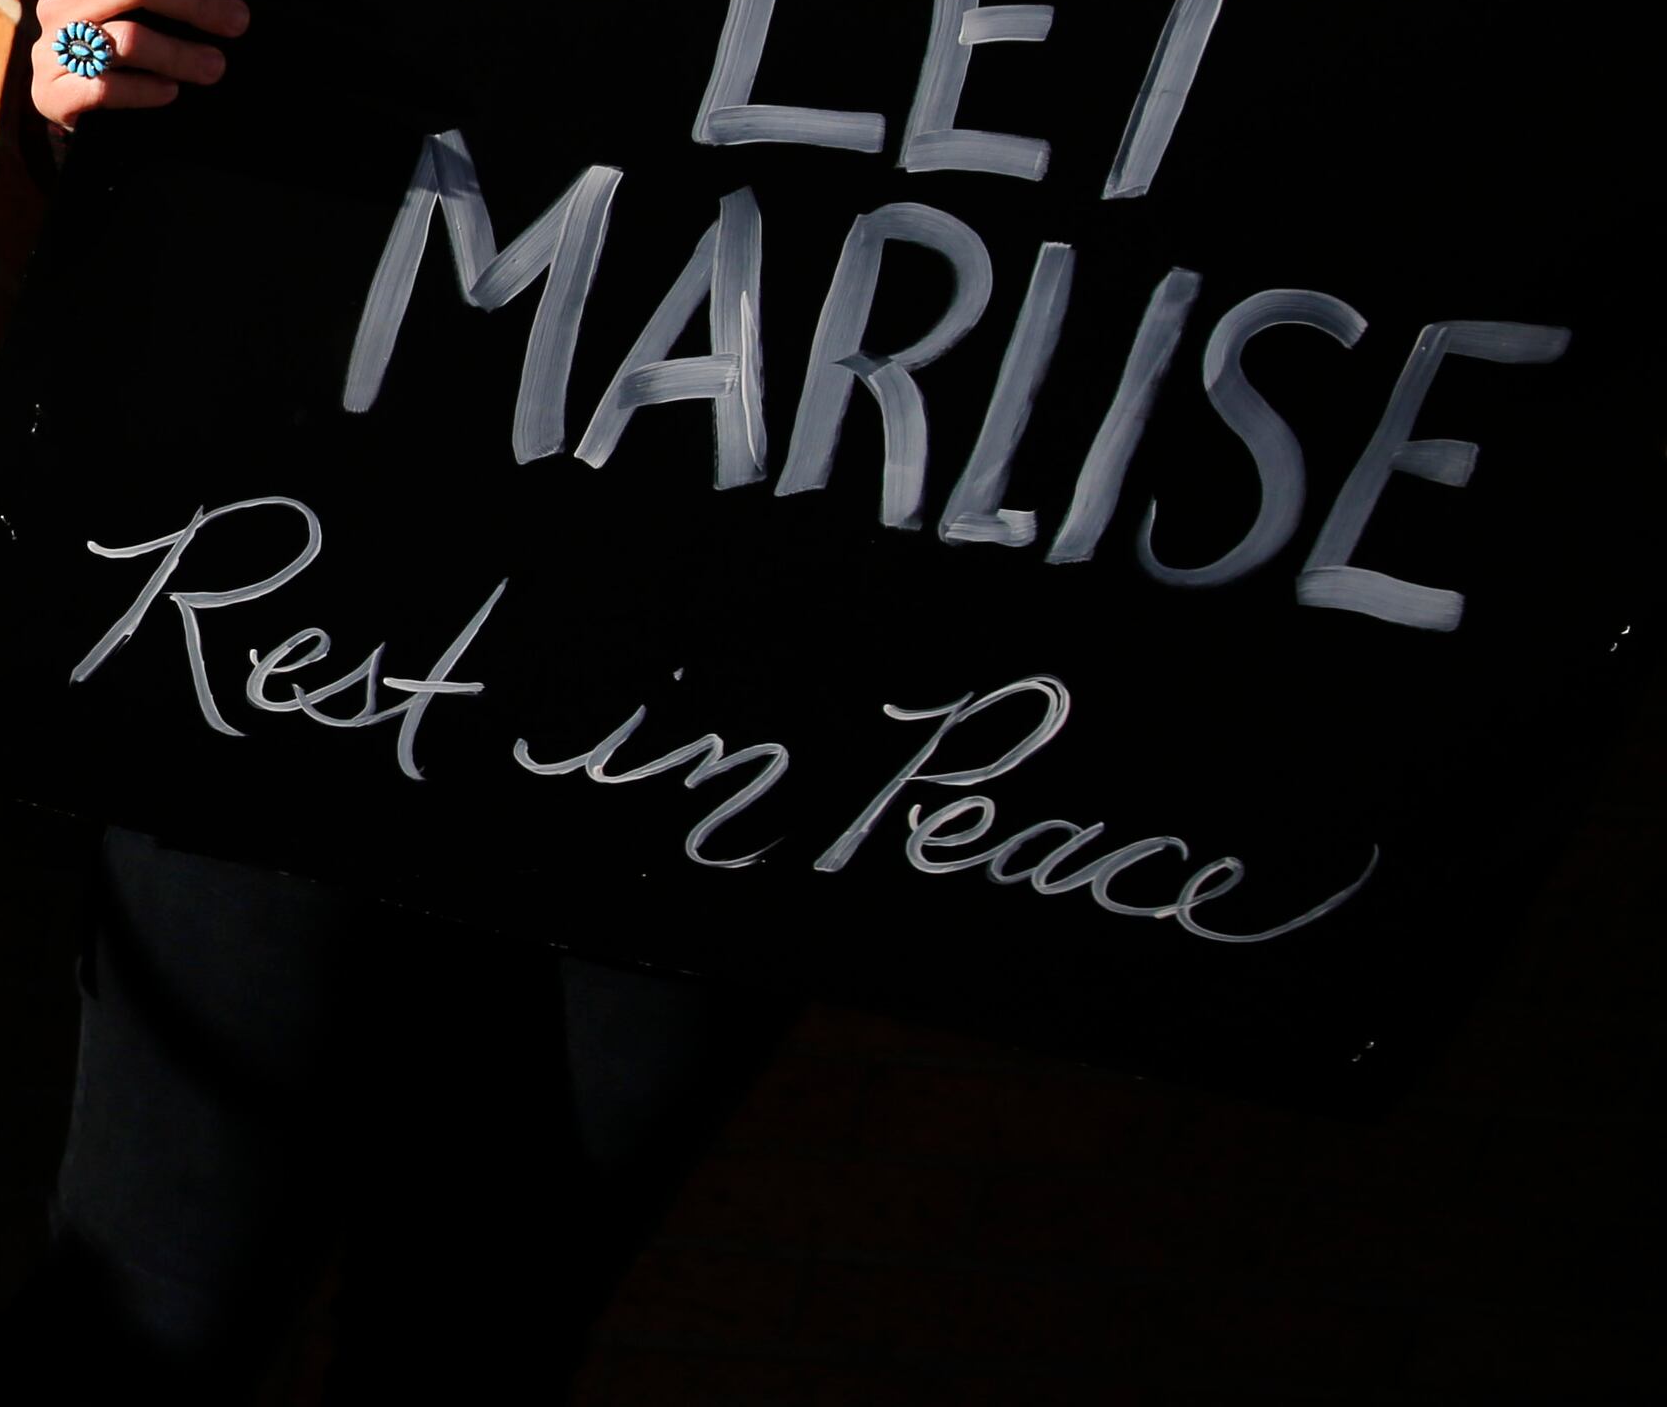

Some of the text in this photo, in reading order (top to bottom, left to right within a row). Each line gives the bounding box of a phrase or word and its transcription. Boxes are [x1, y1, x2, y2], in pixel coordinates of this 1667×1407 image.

[342, 128, 1573, 632] MARLISE
[69, 495, 1380, 944] Rest in Peace
